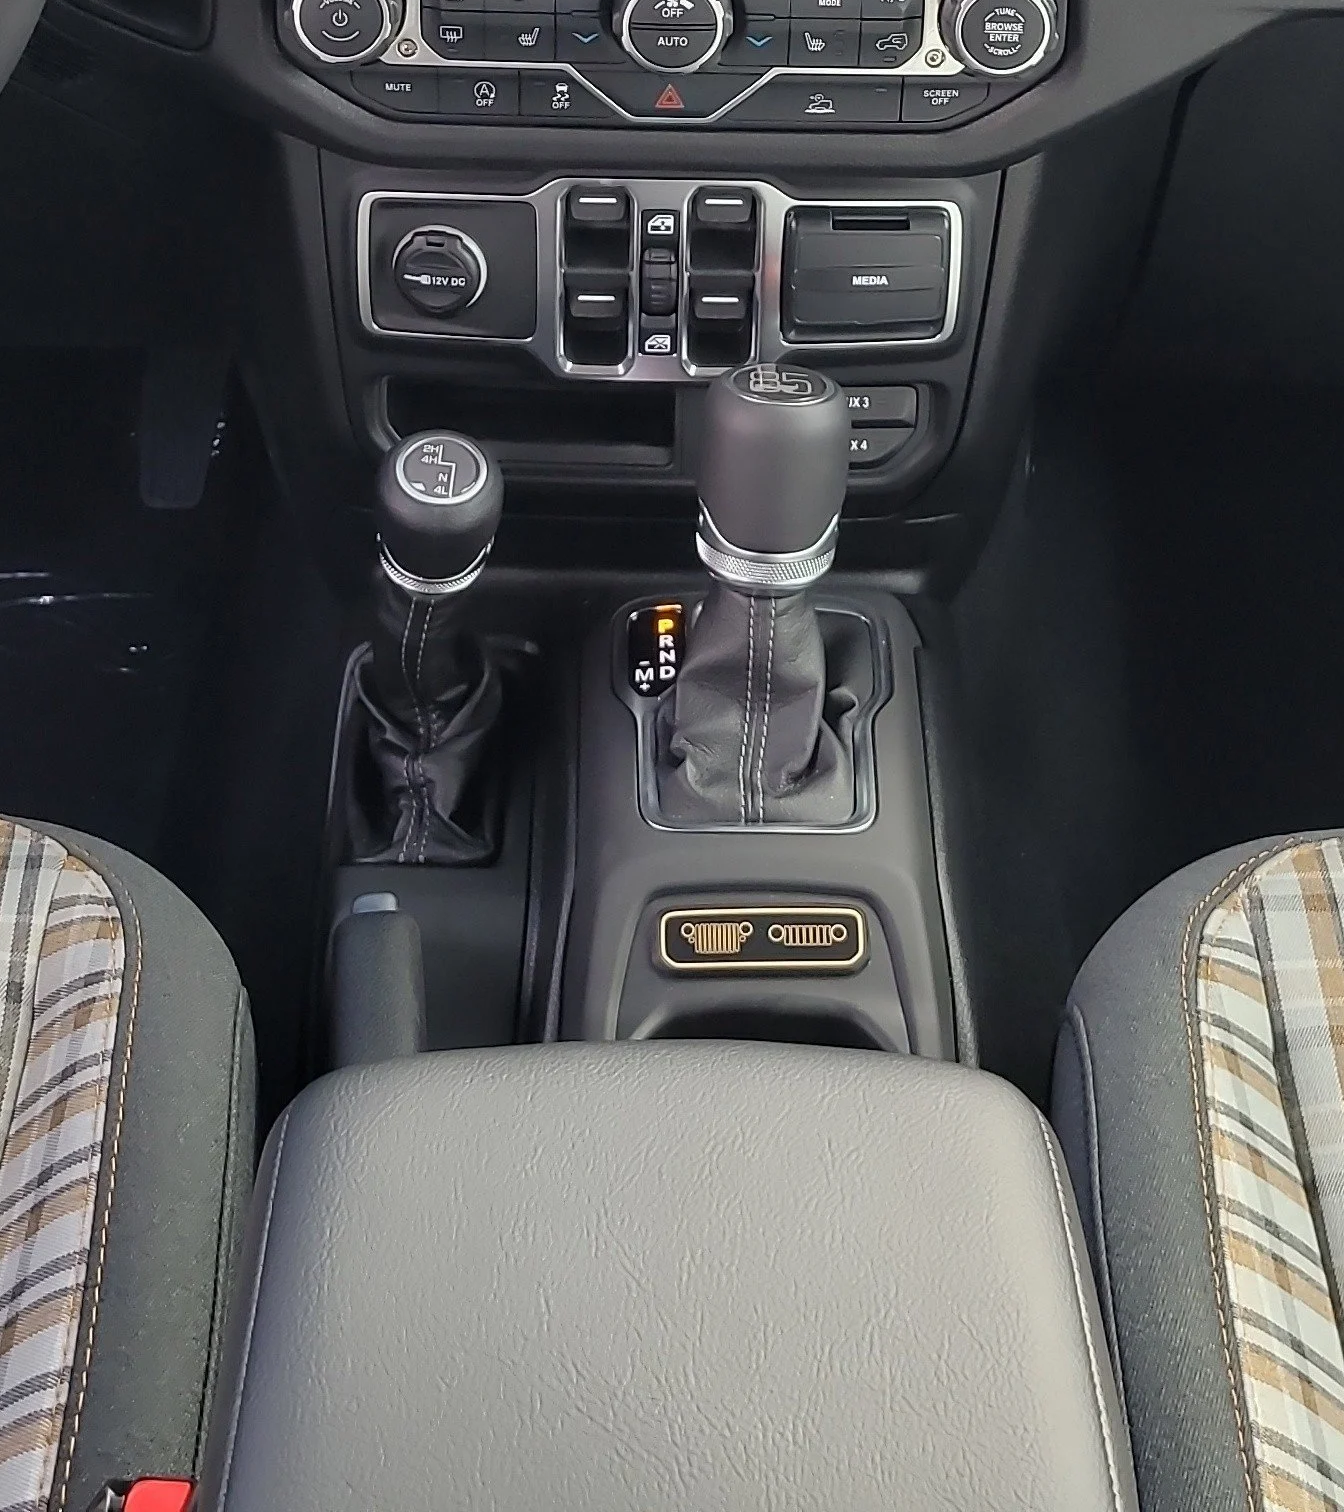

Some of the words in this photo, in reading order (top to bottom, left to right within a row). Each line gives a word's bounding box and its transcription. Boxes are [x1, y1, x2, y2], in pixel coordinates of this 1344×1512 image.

[661, 8, 684, 19] OFF
[994, 7, 1017, 17] TUNE
[984, 22, 1024, 32] BROWSE
[657, 36, 688, 47] AUTO
[989, 33, 1019, 42] ENTER
[987, 45, 1017, 57] SCROLL
[385, 83, 412, 92] MUTE
[923, 89, 959, 98] SCREEN
[475, 98, 494, 108] OFF
[551, 100, 571, 110] OFF
[931, 97, 950, 106] OFF
[431, 276, 450, 286] 12V
[451, 277, 466, 287] DC
[852, 275, 889, 285] MEDIA
[749, 370, 812, 395] 85
[422, 444, 439, 454] 2H
[420, 454, 438, 465] 4H
[439, 472, 448, 483] N
[433, 485, 448, 495] 4L
[657, 618, 674, 633] P
[659, 634, 675, 648] R
[659, 650, 676, 664] N
[634, 667, 654, 682] M
[659, 666, 676, 679] D
